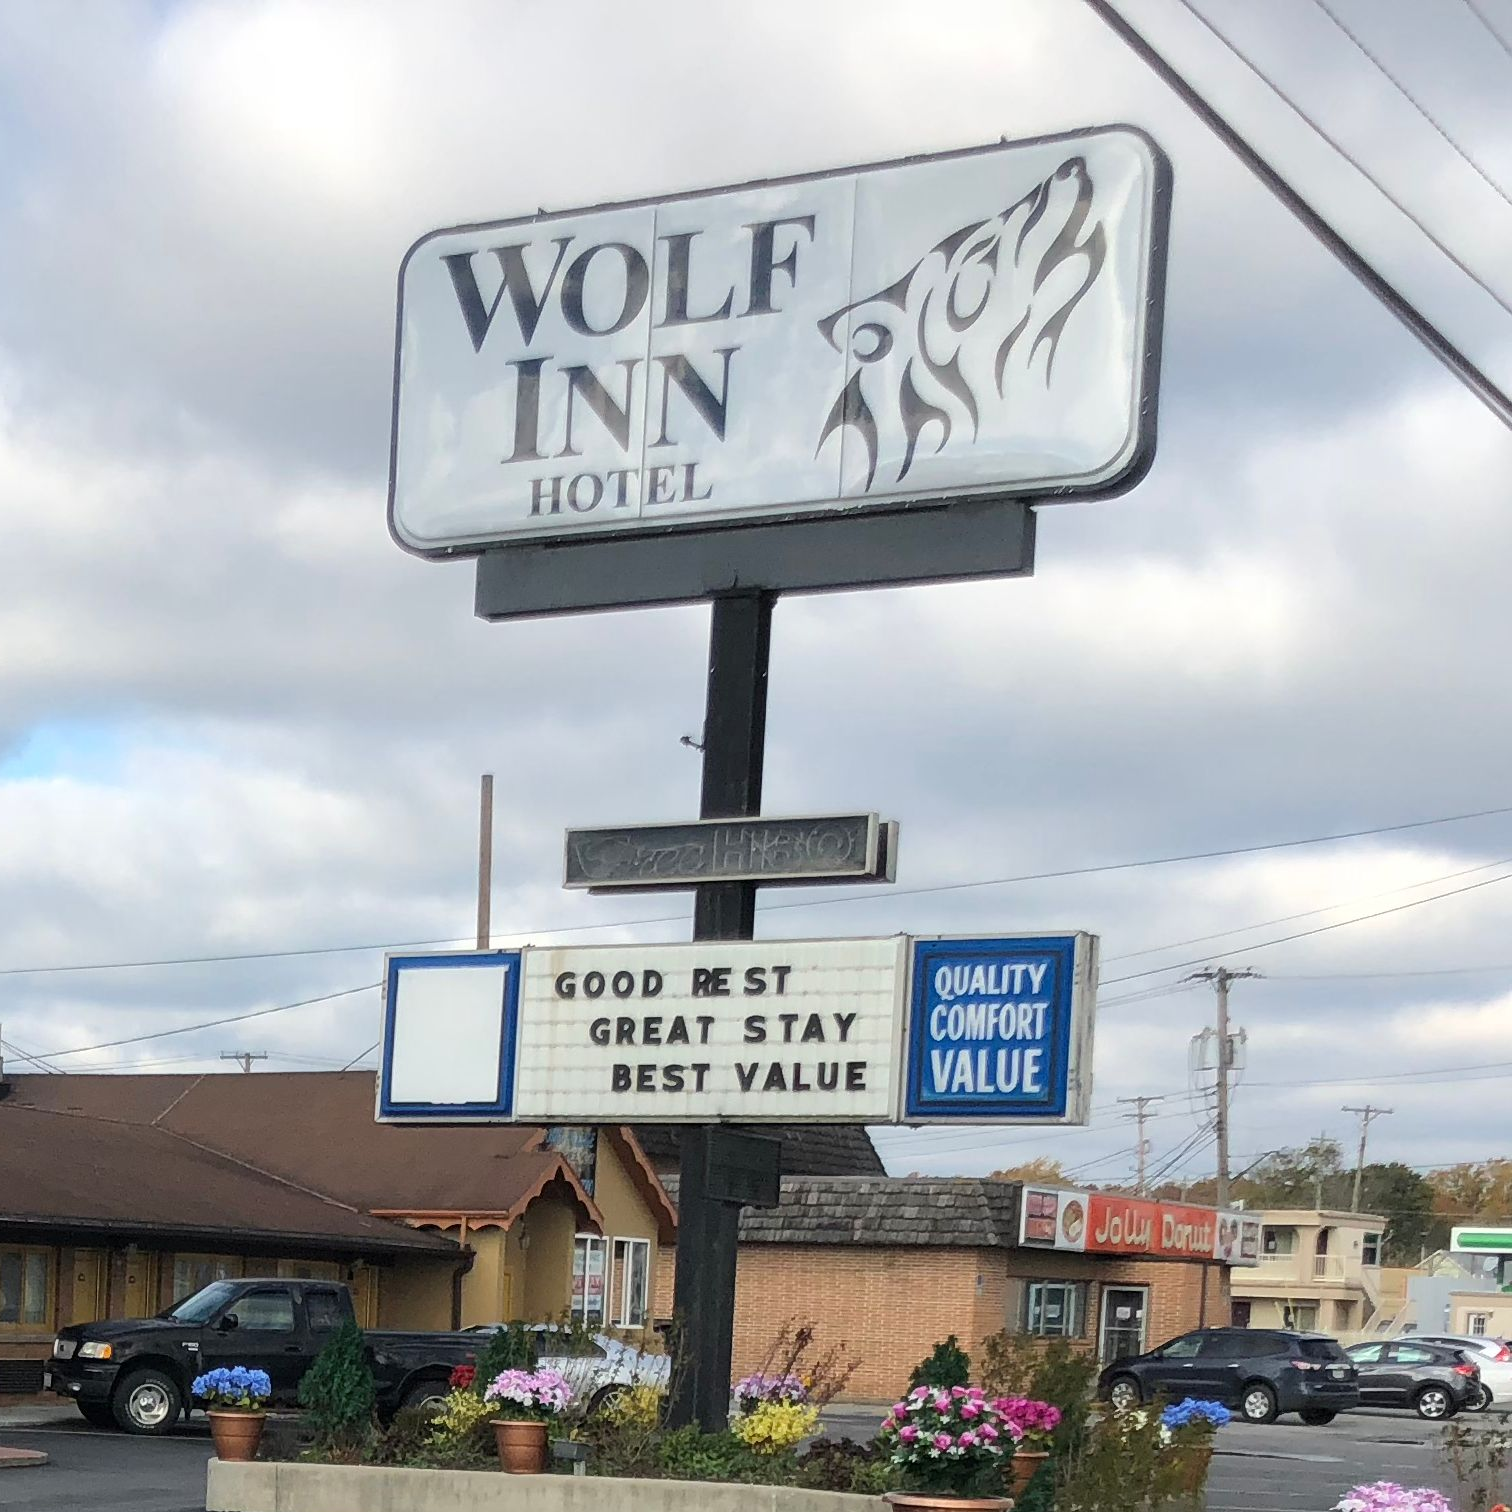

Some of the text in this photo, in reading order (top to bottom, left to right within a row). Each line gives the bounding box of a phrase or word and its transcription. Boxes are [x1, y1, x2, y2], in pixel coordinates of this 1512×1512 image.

[438, 214, 816, 355] WOLF
[500, 346, 741, 467] INN
[527, 463, 714, 518] HOTEL
[554, 965, 792, 1000] GOOD REST
[934, 963, 1048, 1001] QUALITY
[589, 1012, 857, 1047] GREAT STAY
[930, 1002, 1050, 1042] COMFORT
[611, 1060, 868, 1093] BEST VALUE
[930, 1048, 1044, 1094] VALUE
[1161, 1213, 1212, 1253] Donut
